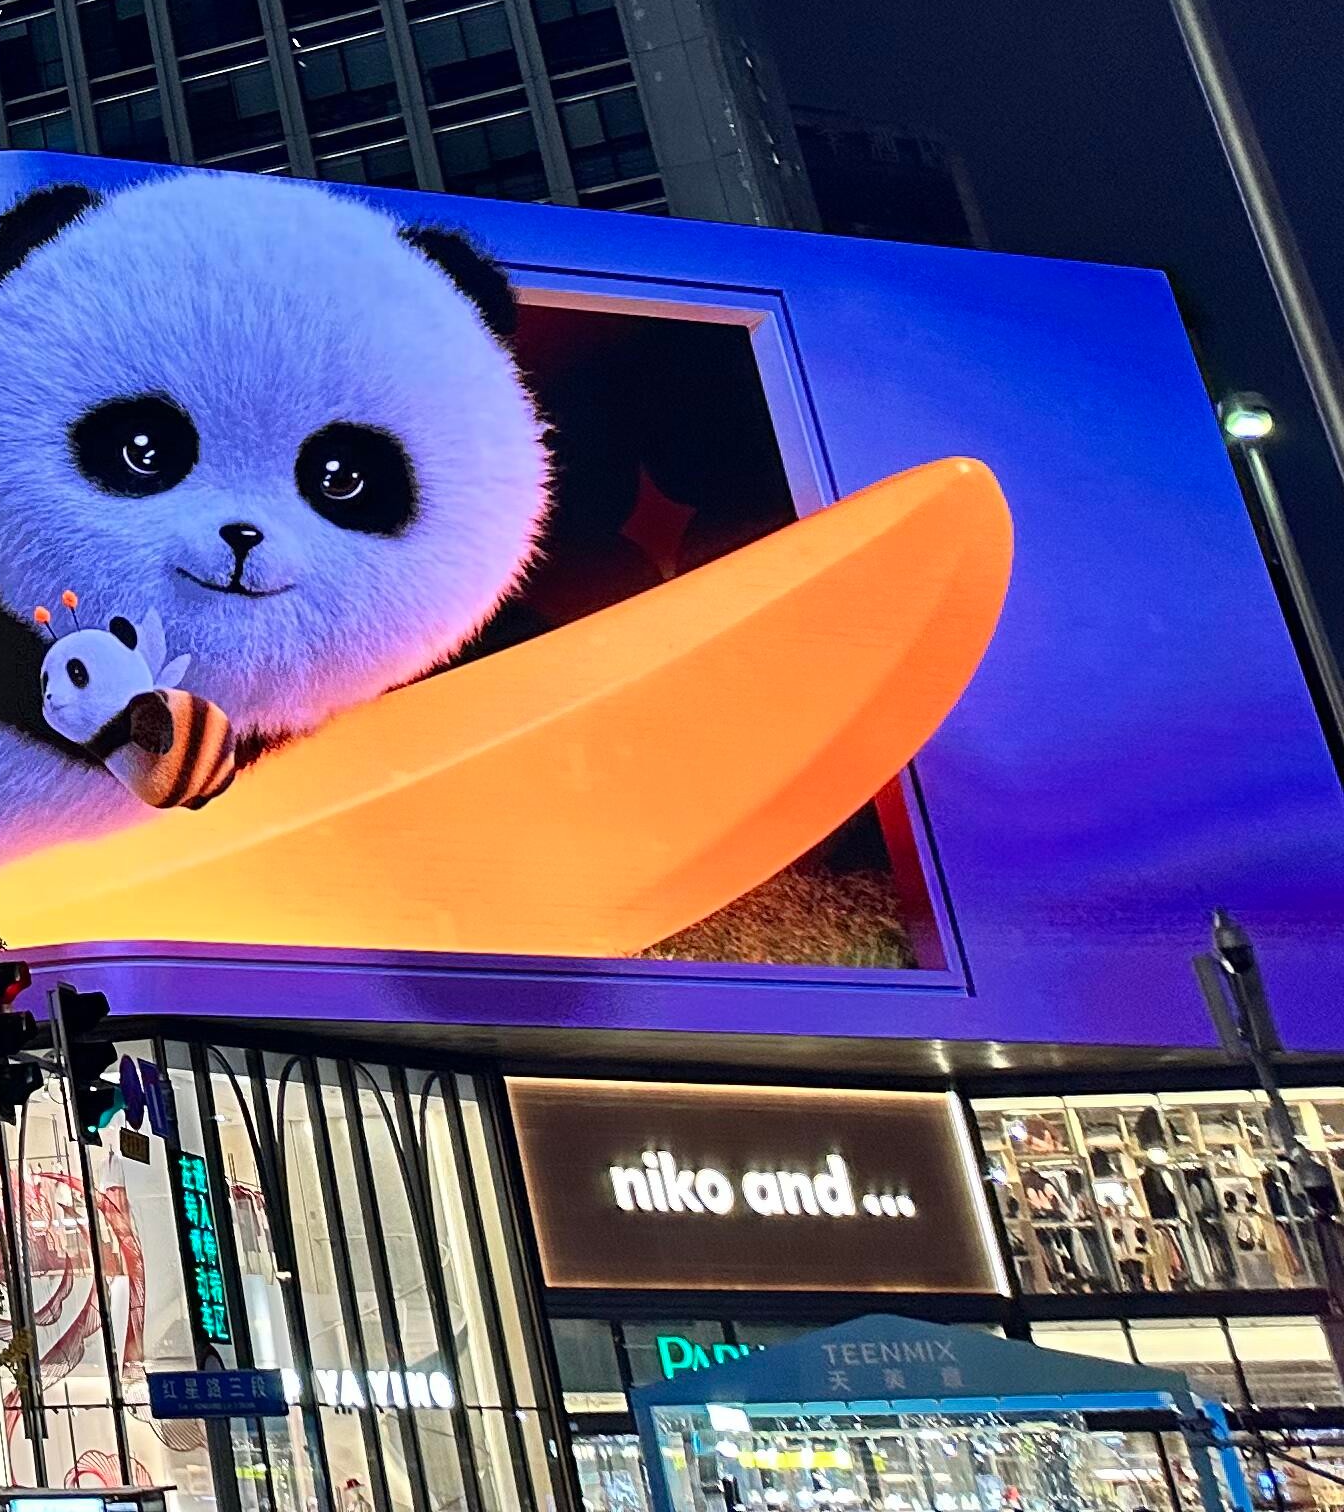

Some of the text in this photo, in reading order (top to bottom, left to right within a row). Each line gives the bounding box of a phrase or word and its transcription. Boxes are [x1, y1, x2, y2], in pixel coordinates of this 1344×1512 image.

[609, 1150, 735, 1215] niko
[742, 1153, 857, 1217] and
[822, 1340, 957, 1366] TEENMIX
[162, 1376, 269, 1400] 红星路三段
